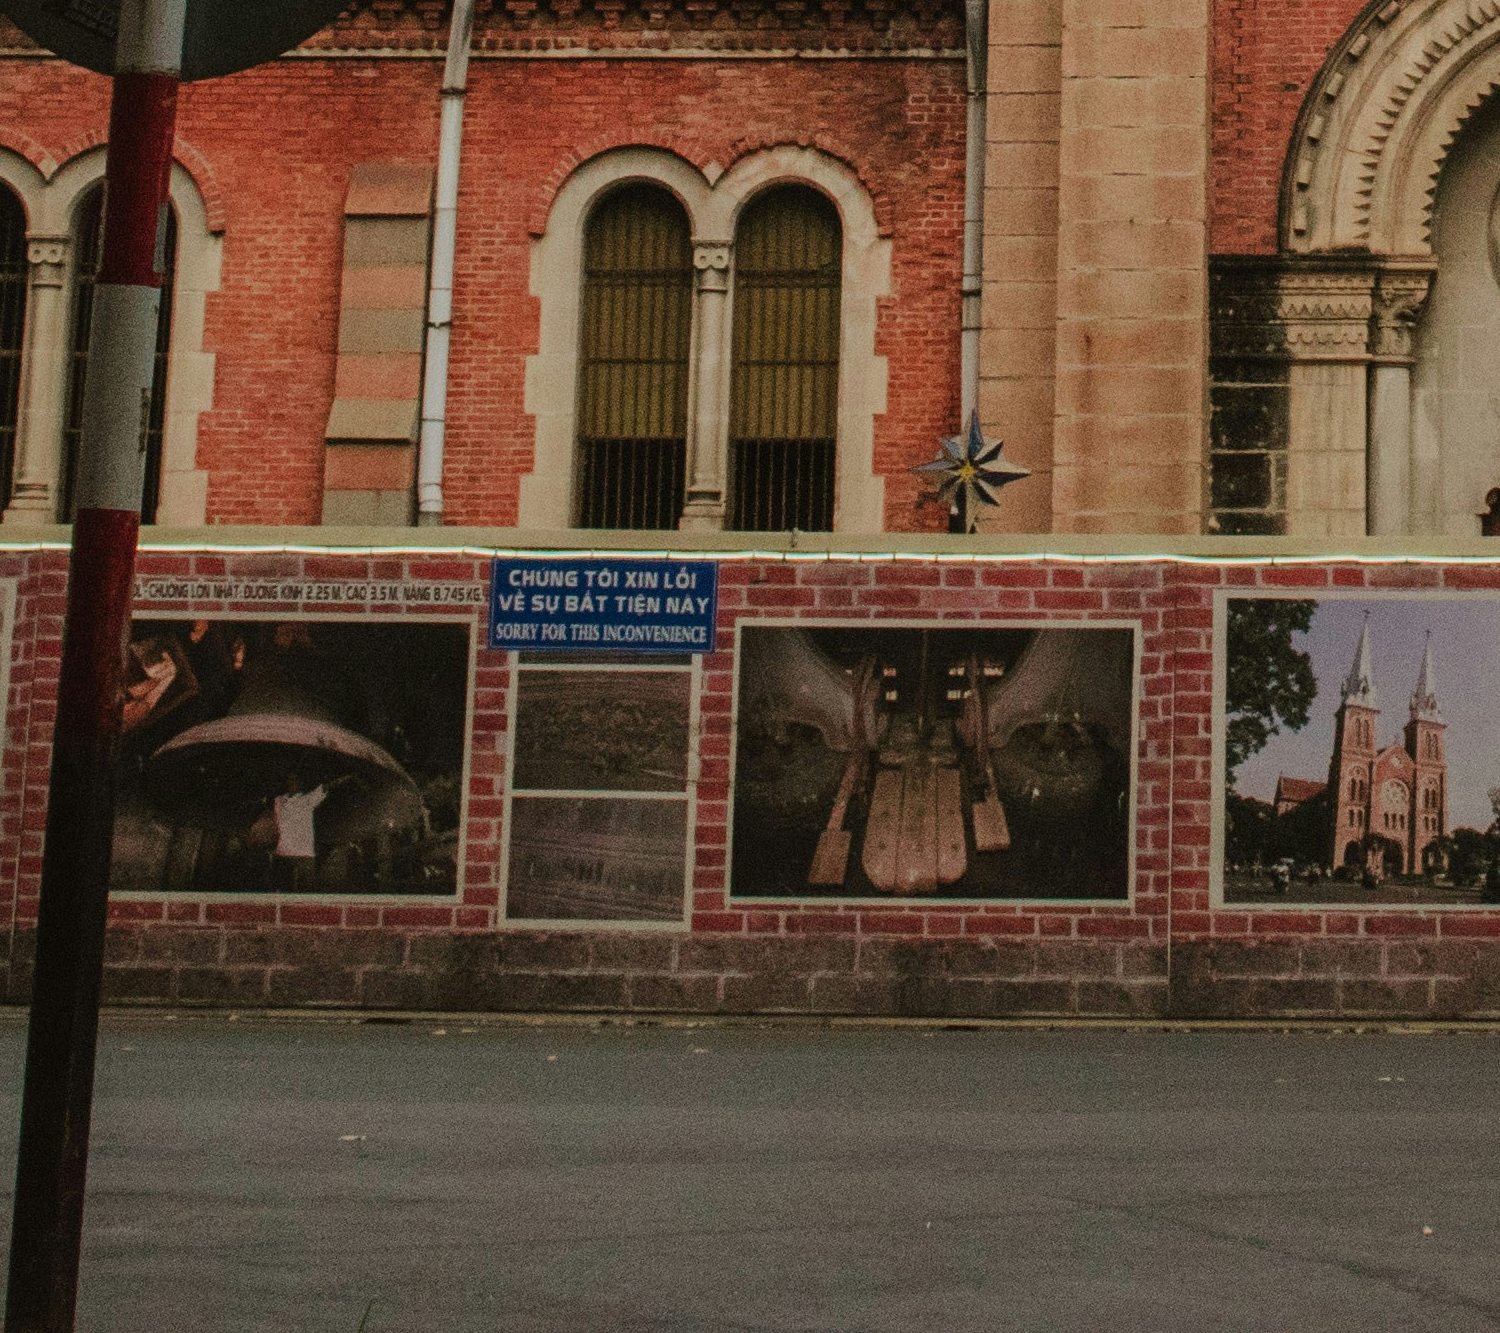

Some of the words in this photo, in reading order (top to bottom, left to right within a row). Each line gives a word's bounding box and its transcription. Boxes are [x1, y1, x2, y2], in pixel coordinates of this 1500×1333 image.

[508, 566, 578, 588] CHÚNG
[584, 568, 619, 588] TÔI
[624, 570, 659, 589] XIN
[346, 585, 368, 602] CAO
[614, 593, 661, 616] TIỆN
[495, 622, 540, 642] SORRY
[541, 623, 567, 642] FOR
[569, 624, 600, 643] THIS
[602, 624, 708, 644] INCONVENIENCE
